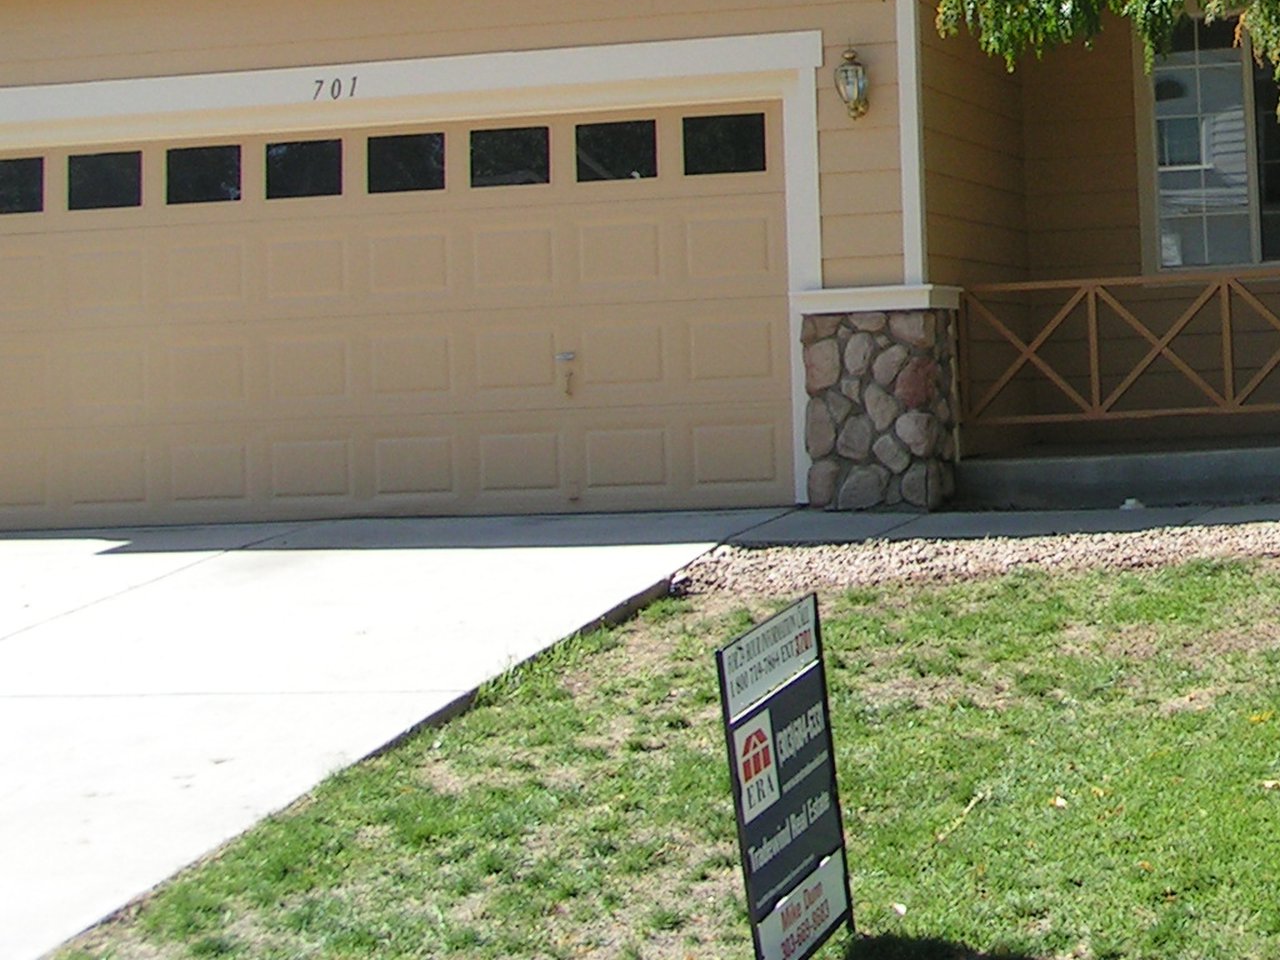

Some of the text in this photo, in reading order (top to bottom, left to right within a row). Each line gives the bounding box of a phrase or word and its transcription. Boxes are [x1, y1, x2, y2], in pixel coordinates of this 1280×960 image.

[313, 75, 358, 100] 701
[781, 640, 794, 663] EXT
[746, 773, 775, 810] ERA
[789, 803, 809, 839] Real
[807, 792, 830, 825] Estate
[781, 902, 801, 932] Mike
